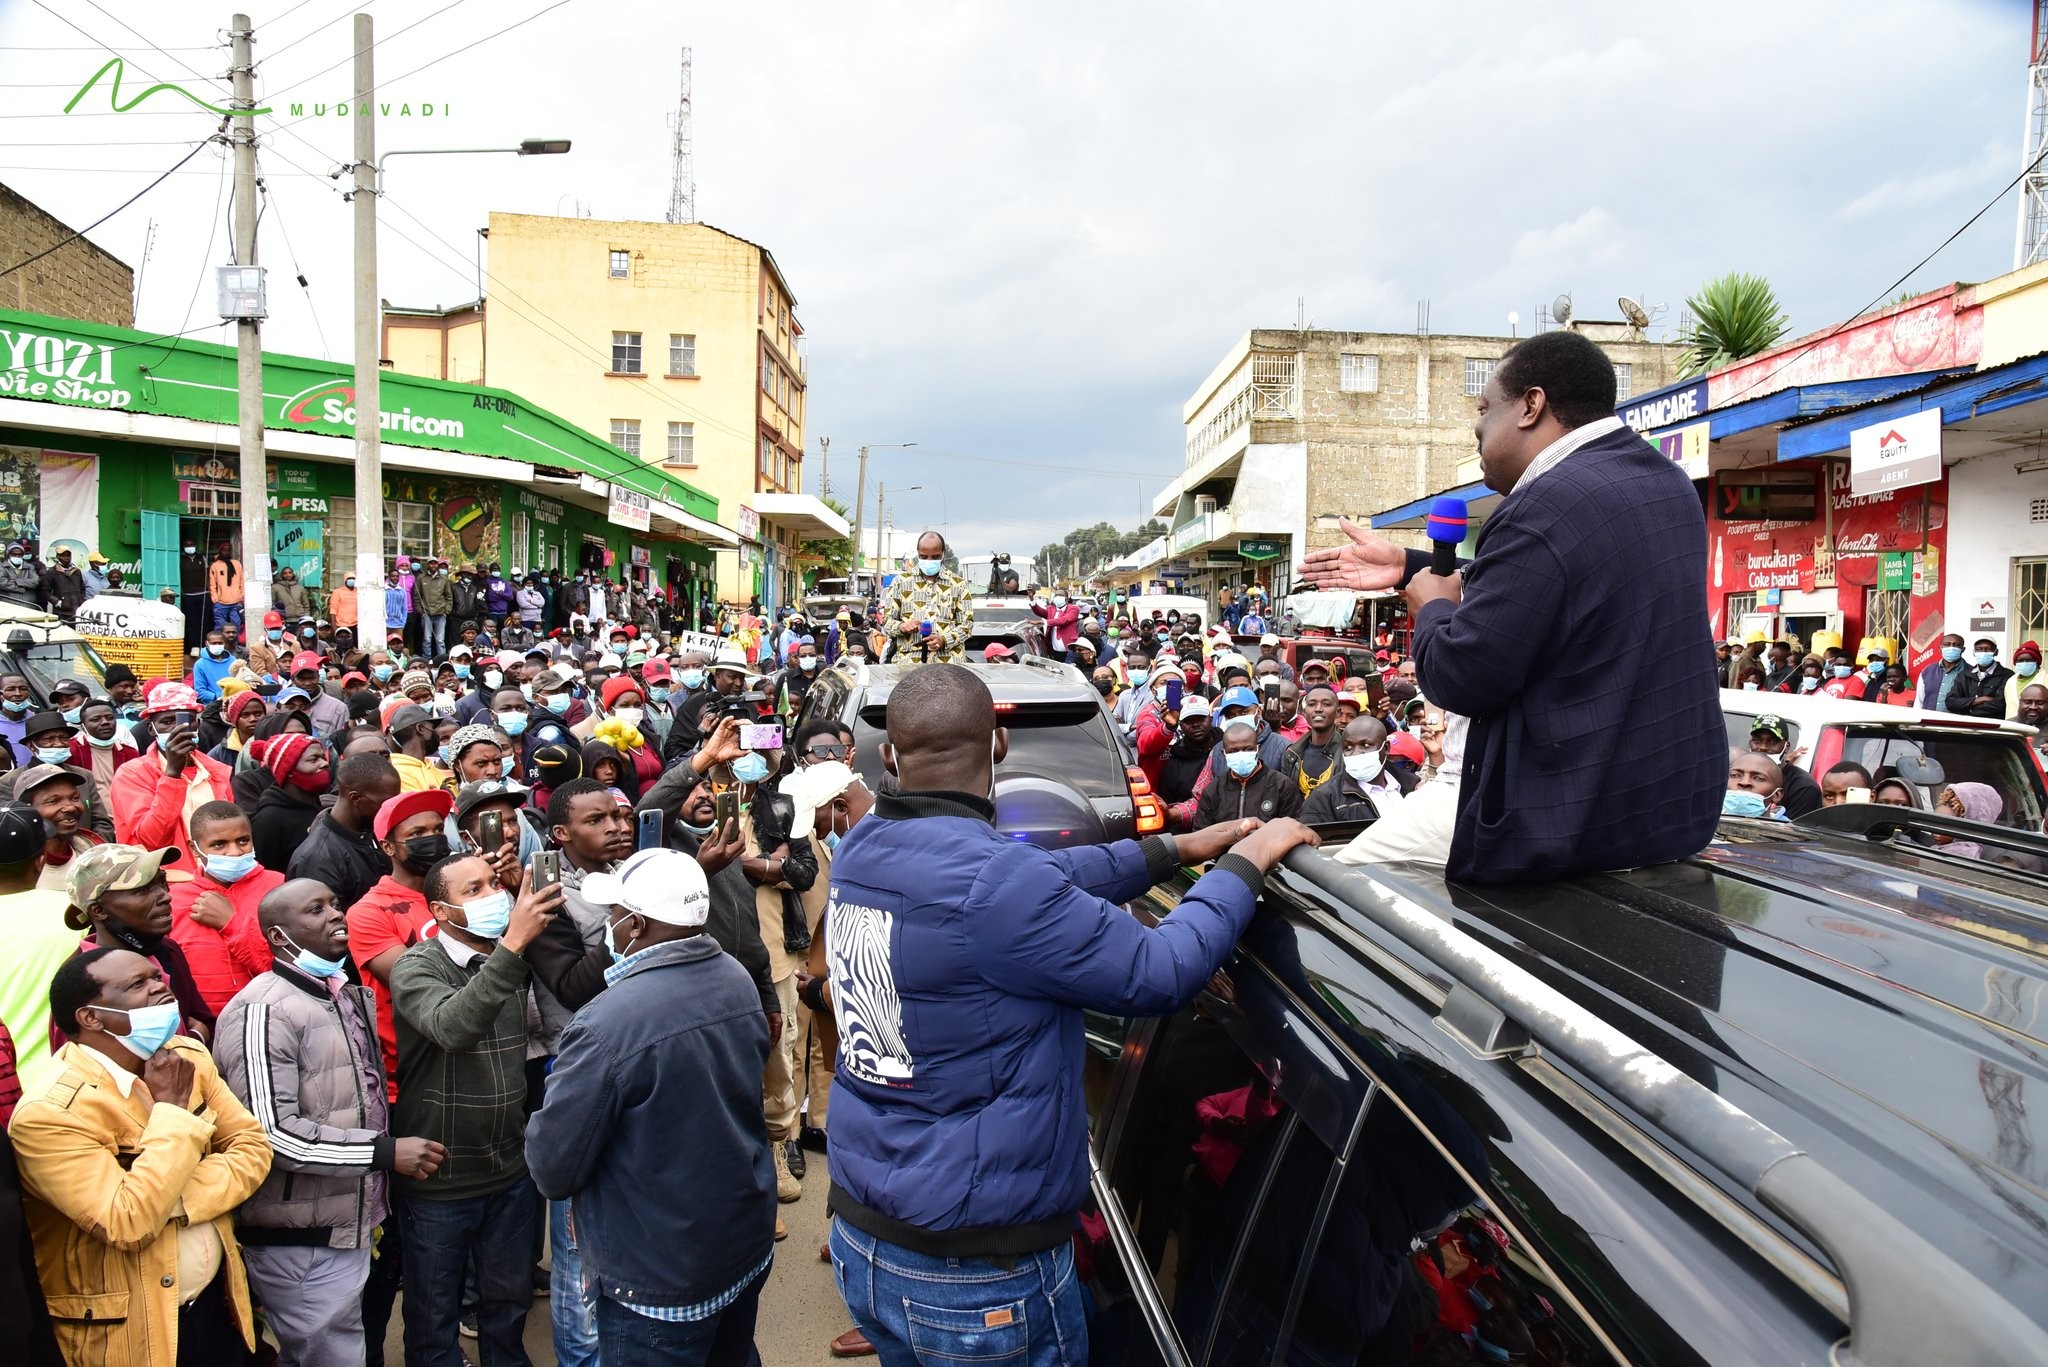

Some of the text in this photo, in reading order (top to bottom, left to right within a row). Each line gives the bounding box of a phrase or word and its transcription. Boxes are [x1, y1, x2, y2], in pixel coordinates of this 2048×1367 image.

[52, 379, 131, 408] Shop
[323, 398, 464, 438] Saaricom
[1625, 389, 1697, 432] FARMCARE
[1880, 444, 1908, 459] EQUITY
[284, 469, 298, 477] TOP
[1880, 469, 1909, 485] AGENT
[1724, 487, 1760, 514] yu
[277, 527, 303, 553] LEON
[1748, 569, 1799, 588] Coke baridi
[1885, 569, 1904, 577] HAPA
[123, 629, 167, 638] CAMPUS
[106, 640, 139, 650] MIKONO
[1912, 648, 1934, 667] SCONES
